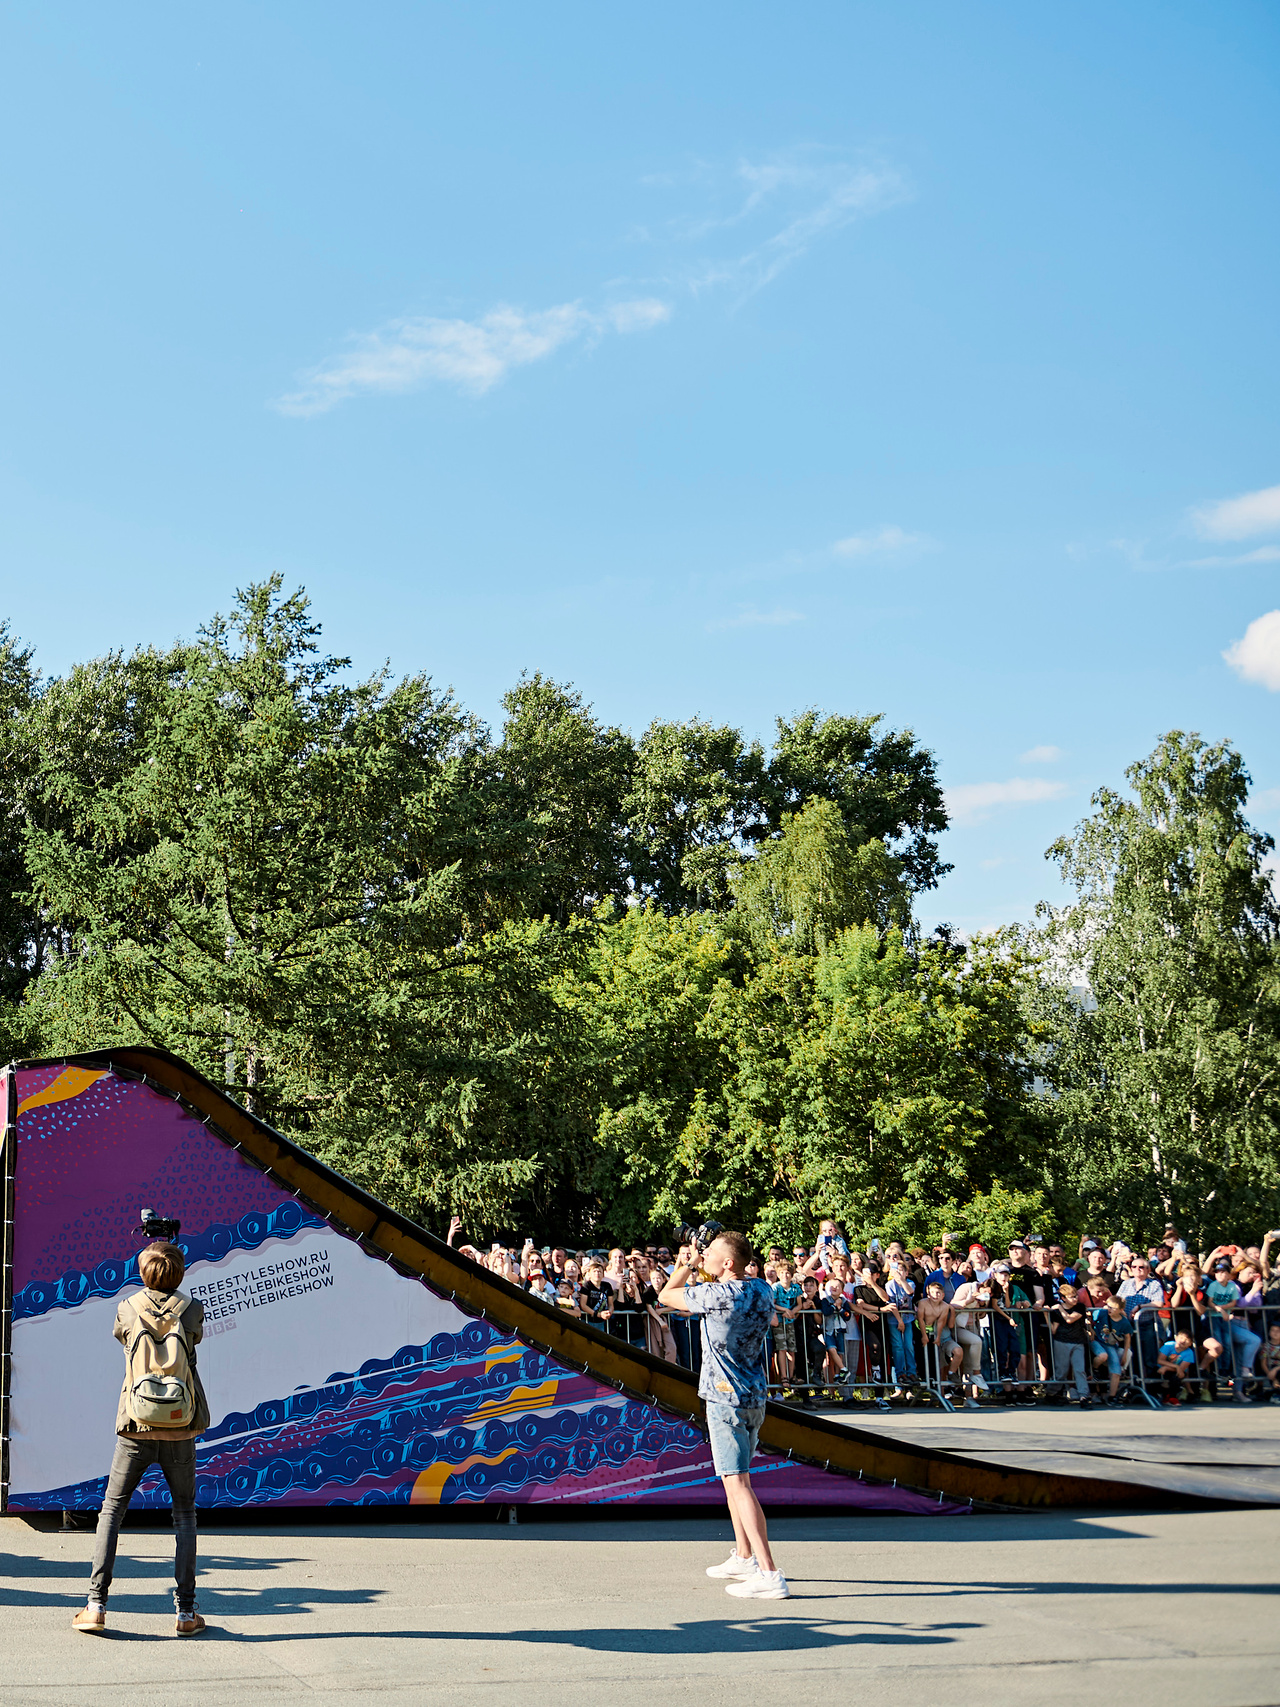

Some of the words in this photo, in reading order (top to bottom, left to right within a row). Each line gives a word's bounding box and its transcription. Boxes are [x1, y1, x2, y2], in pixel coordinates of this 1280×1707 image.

[190, 1250, 329, 1299] FREESTYLESHOW.RU
[201, 1262, 331, 1308] REESTYLEBIKESHOW
[204, 1275, 334, 1322] REESTYLEBIKESHOW
